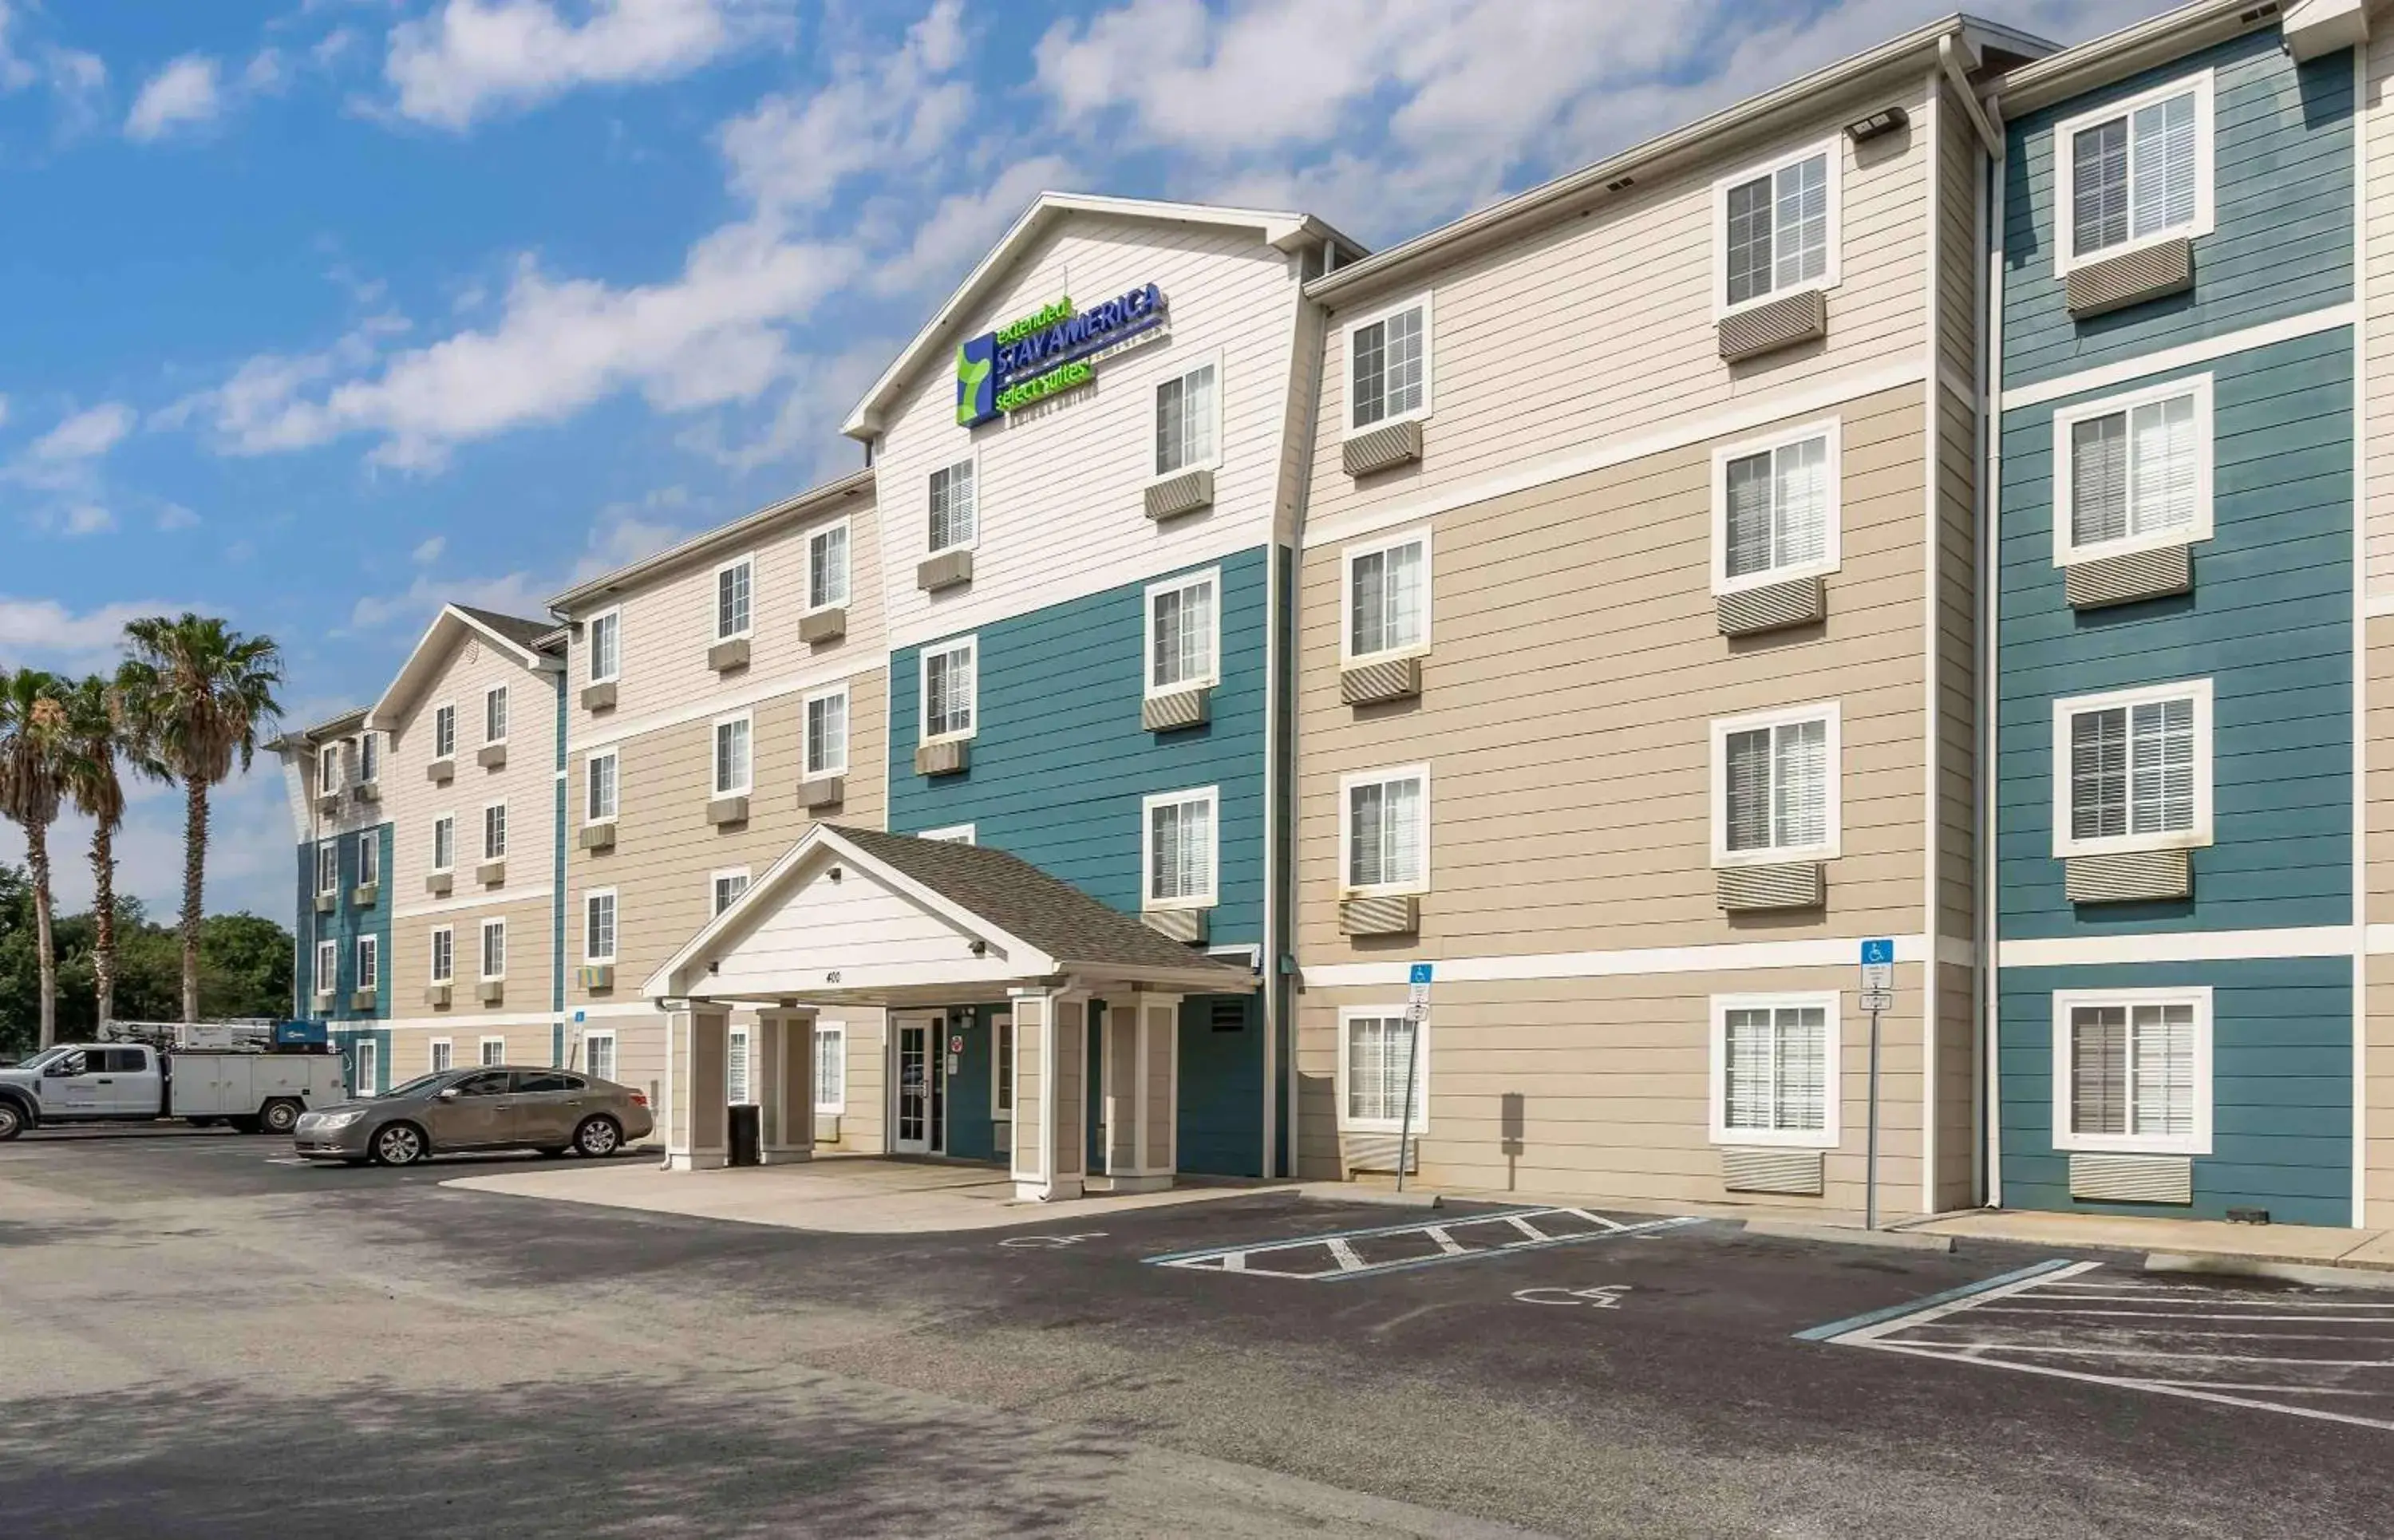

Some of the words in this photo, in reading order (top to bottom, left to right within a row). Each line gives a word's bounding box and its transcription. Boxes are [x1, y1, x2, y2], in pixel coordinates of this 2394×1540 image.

[997, 297, 1070, 345] extended
[995, 379, 1041, 410] select
[1041, 361, 1088, 396] suites
[826, 971, 840, 983] 400
